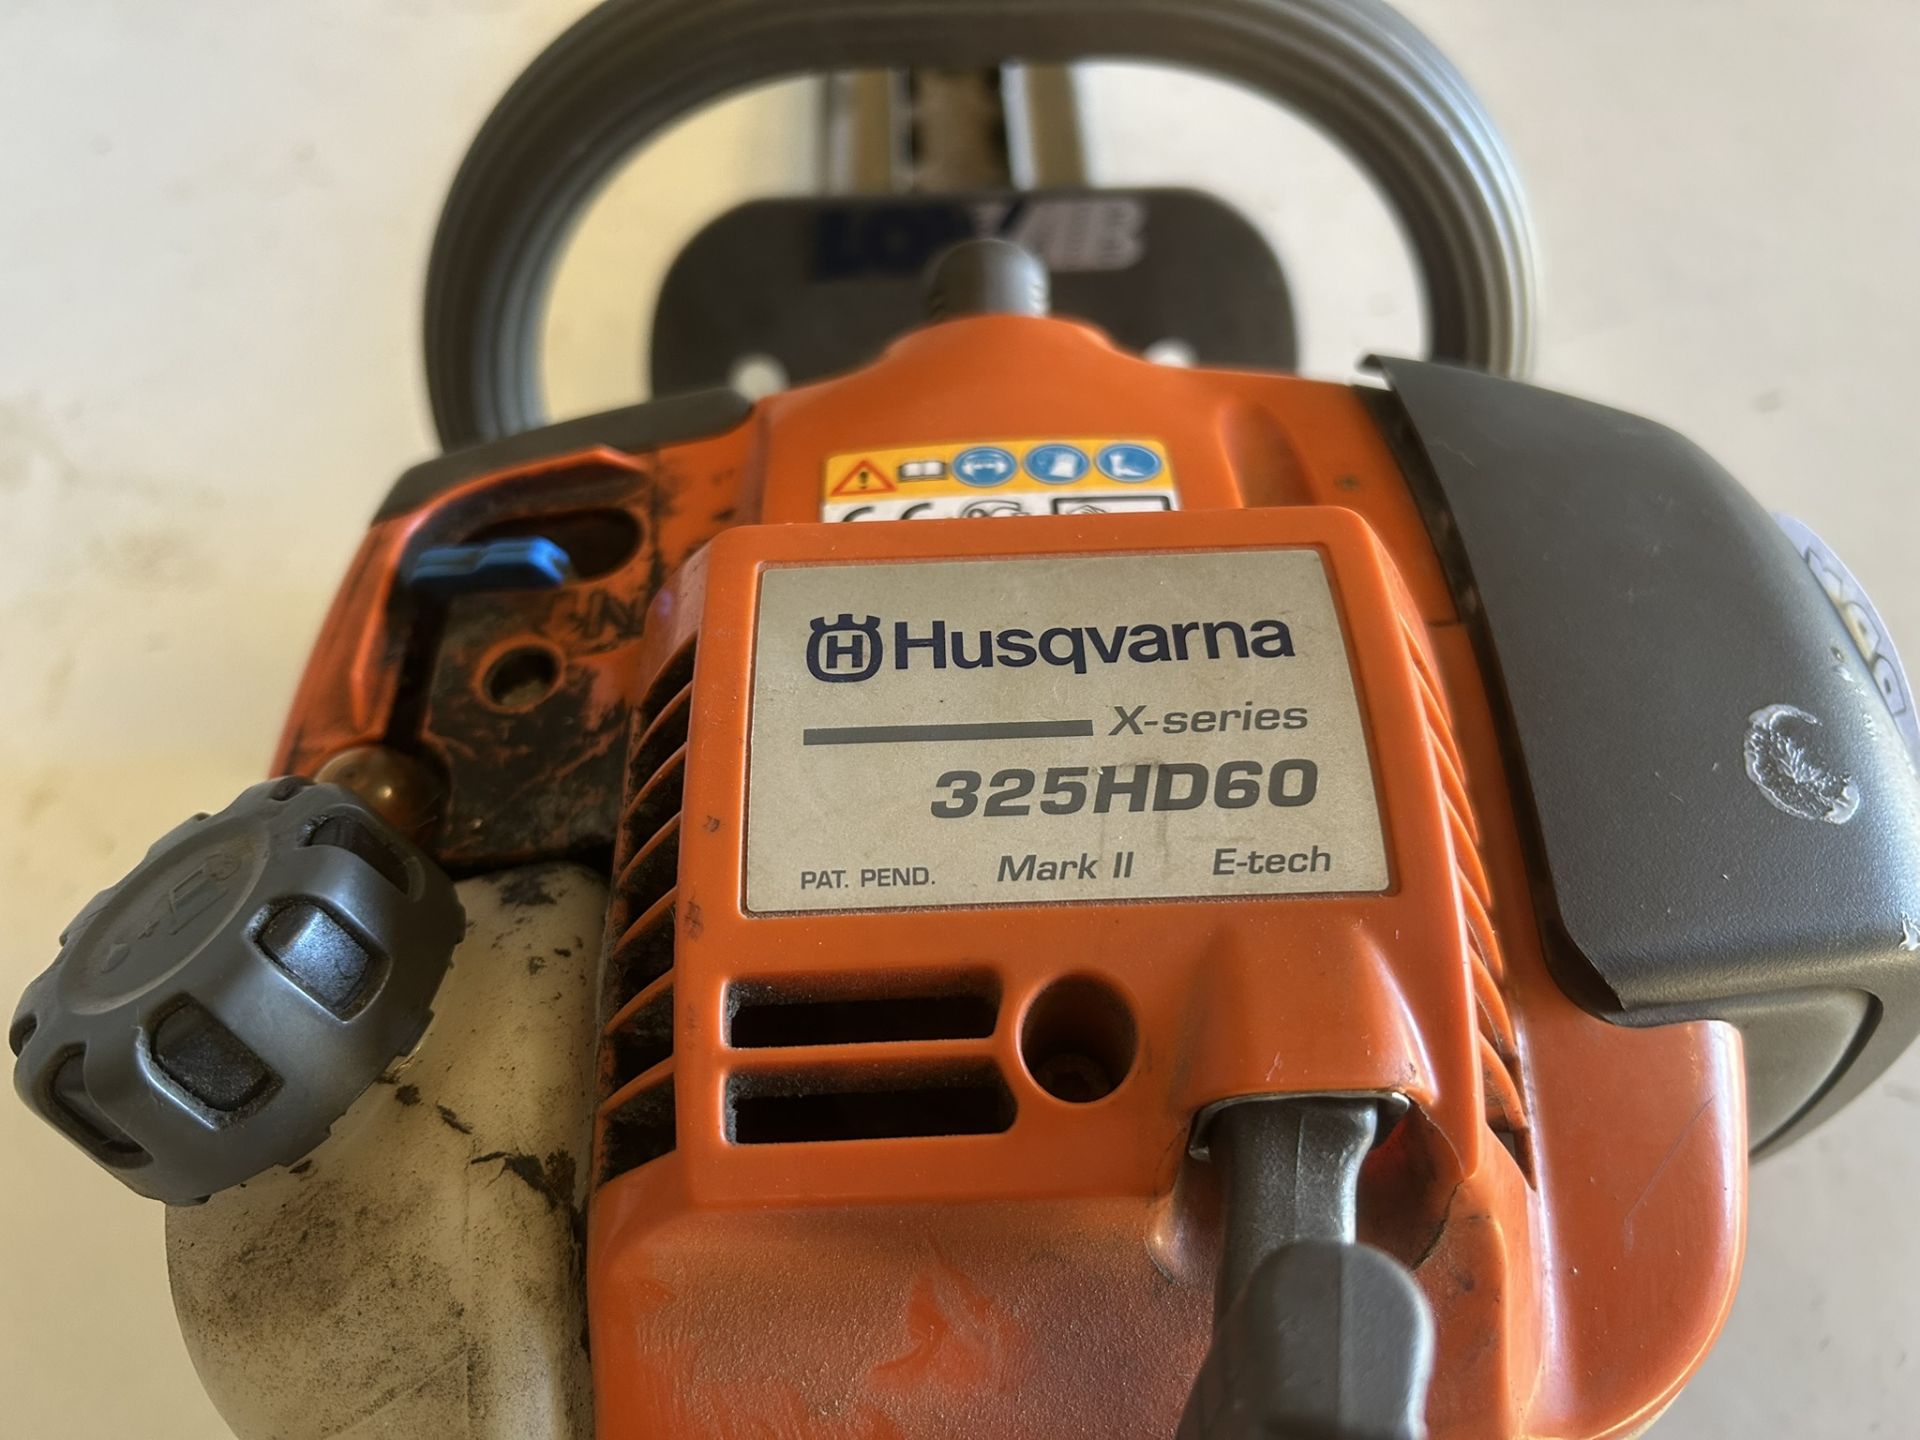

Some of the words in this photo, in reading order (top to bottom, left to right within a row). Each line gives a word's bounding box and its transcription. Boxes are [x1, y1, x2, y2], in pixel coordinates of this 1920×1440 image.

[894, 619, 1296, 675] Husqvarna
[1108, 701, 1308, 737] X-series
[930, 758, 1318, 819] 325HD60
[801, 869, 849, 890] PAT.
[860, 865, 936, 889] PEND.
[997, 853, 1098, 883] Mark
[1113, 851, 1134, 879] II
[1212, 845, 1331, 877] E-tech
